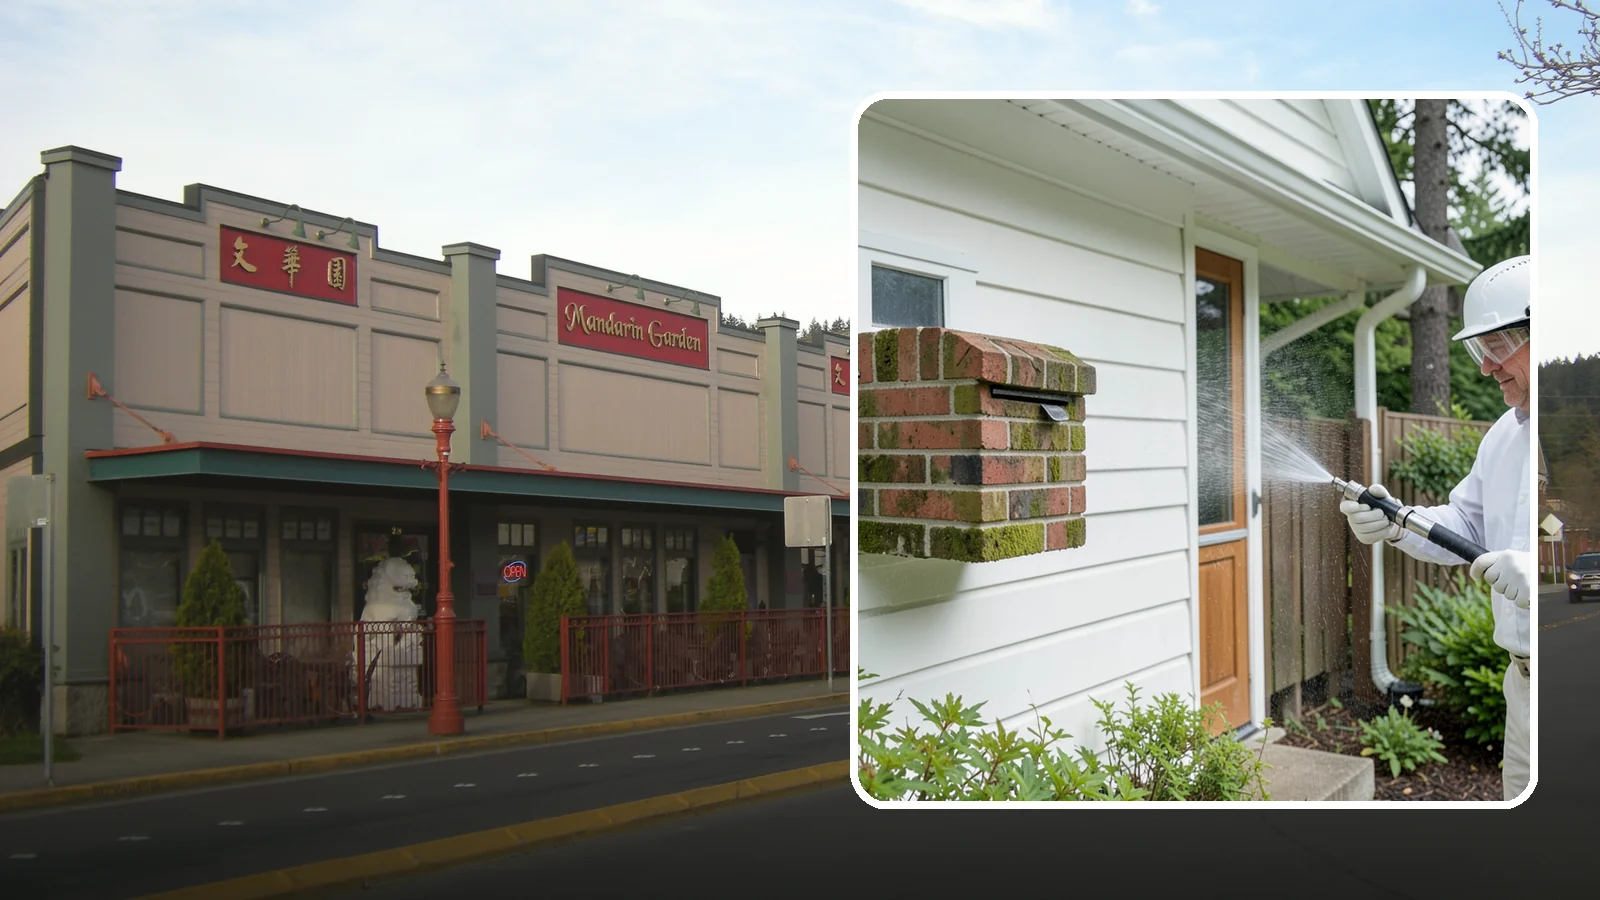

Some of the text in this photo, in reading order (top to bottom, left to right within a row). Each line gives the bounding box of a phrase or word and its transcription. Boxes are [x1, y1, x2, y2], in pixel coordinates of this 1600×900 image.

[231, 235, 346, 291] 文華園
[564, 302, 701, 352] Mandarin Garden
[503, 565, 527, 578] OPEN
